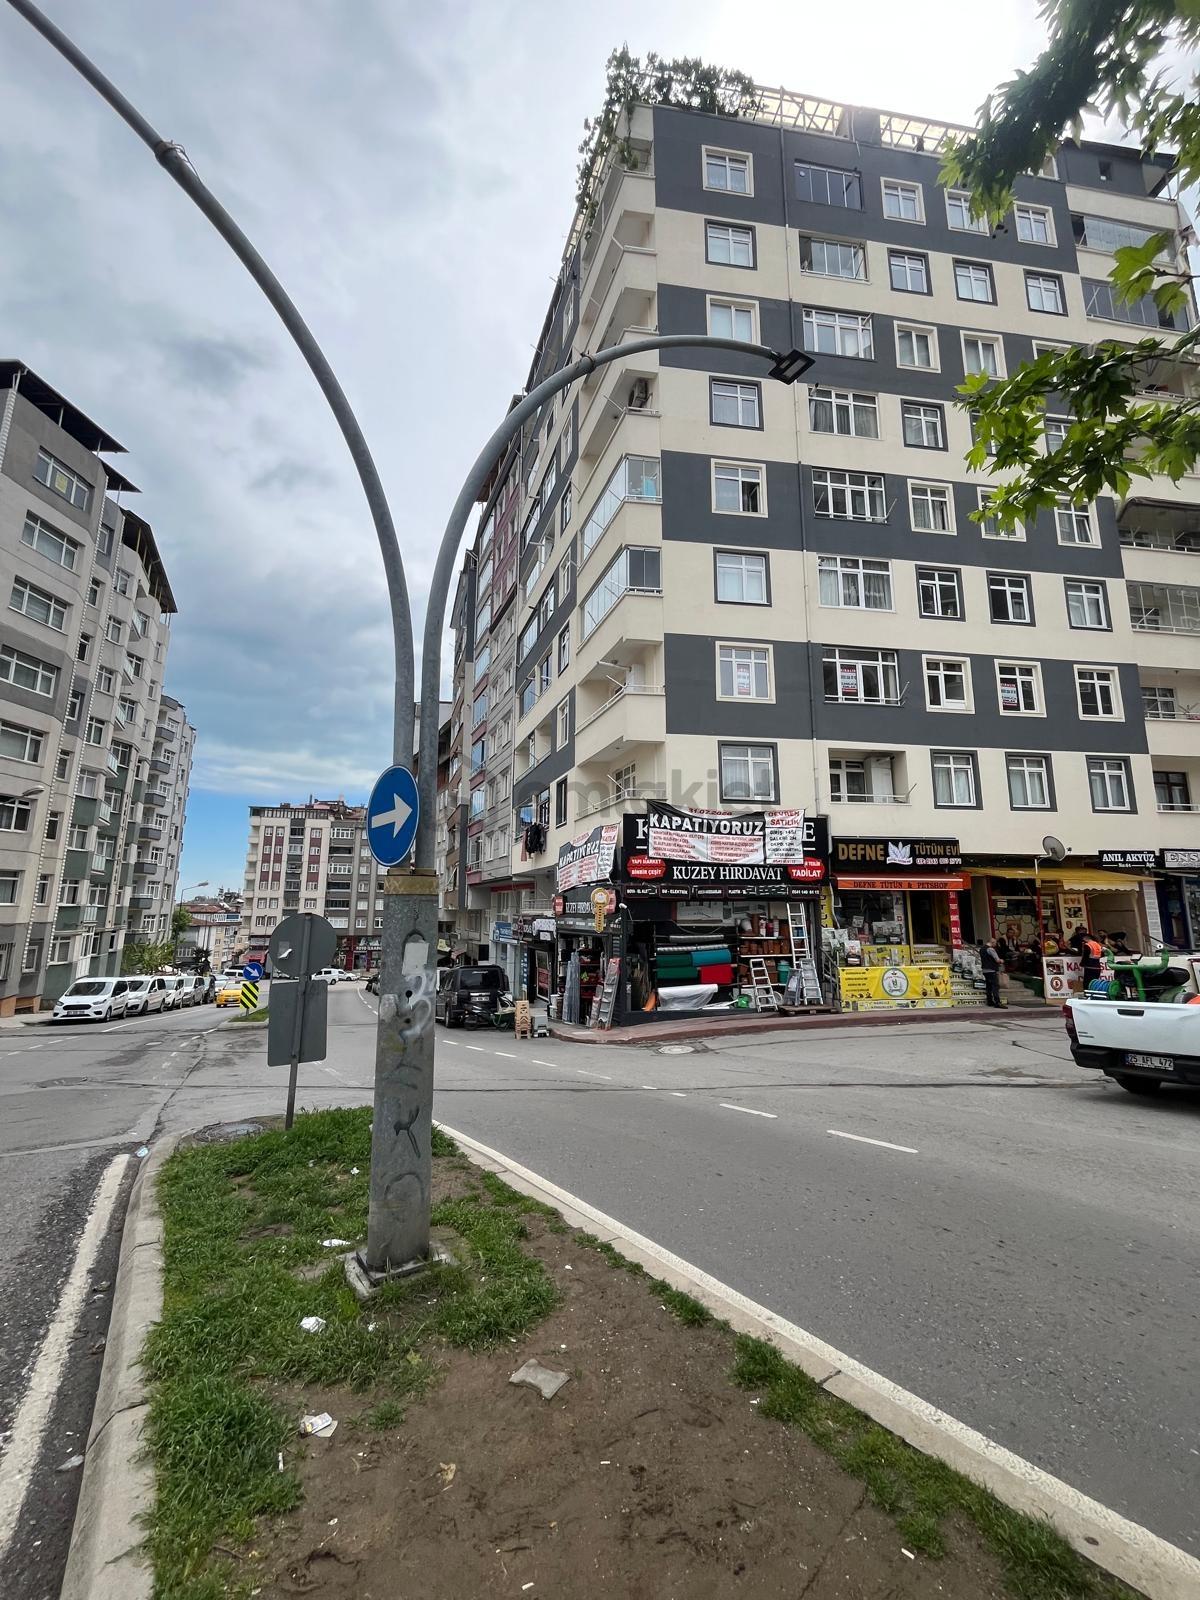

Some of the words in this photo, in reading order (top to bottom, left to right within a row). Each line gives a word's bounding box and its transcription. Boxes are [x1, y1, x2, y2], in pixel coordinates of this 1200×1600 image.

[649, 813, 764, 836] KAPATIYORUZ
[838, 843, 885, 861] DEFNE
[914, 842, 944, 856] TÜTÜN
[945, 843, 960, 856] EVİ
[1102, 853, 1124, 862] ANIL
[1125, 851, 1155, 862] AKYÜZ
[672, 866, 717, 880] KUZEY
[791, 868, 821, 877] TADİLAT
